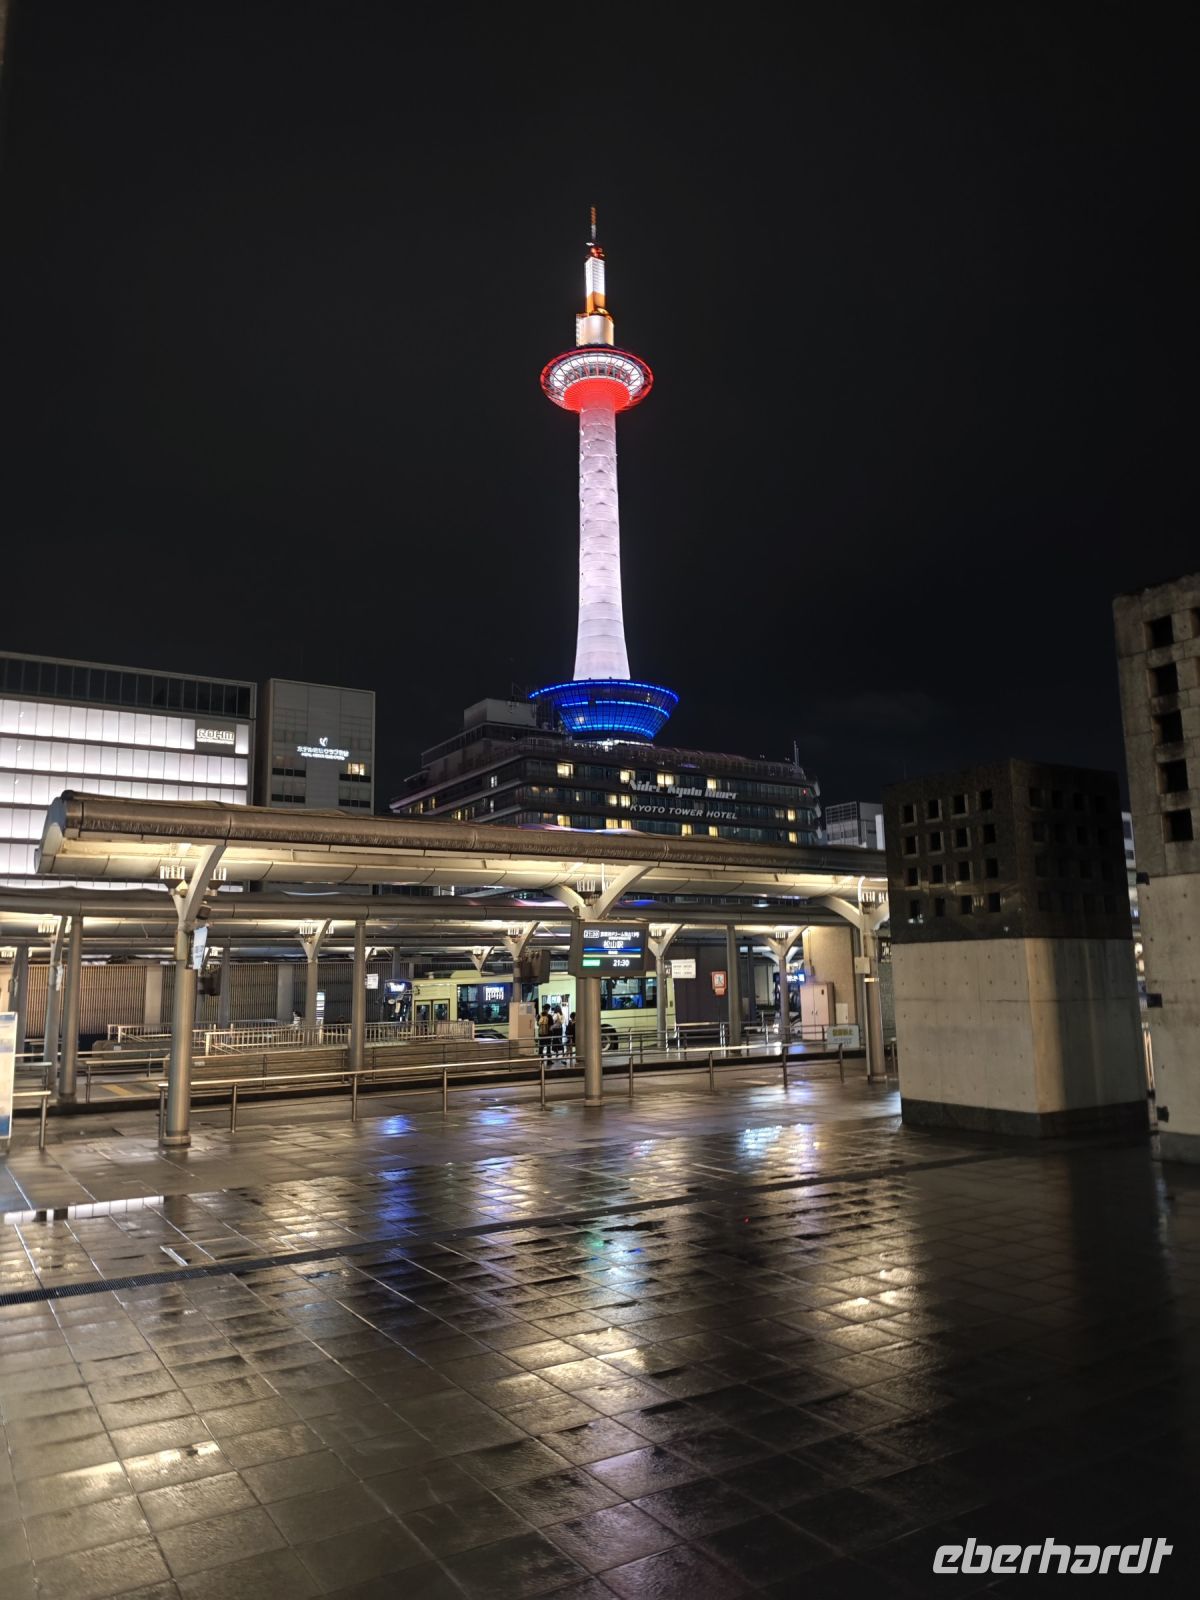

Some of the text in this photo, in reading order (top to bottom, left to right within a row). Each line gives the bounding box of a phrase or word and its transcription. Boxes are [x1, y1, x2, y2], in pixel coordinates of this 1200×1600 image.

[196, 728, 235, 741] ROHM
[667, 785, 703, 798] Kyoto
[629, 804, 738, 820] KYOTO TOWER HOTEL
[613, 959, 630, 967] 21:30
